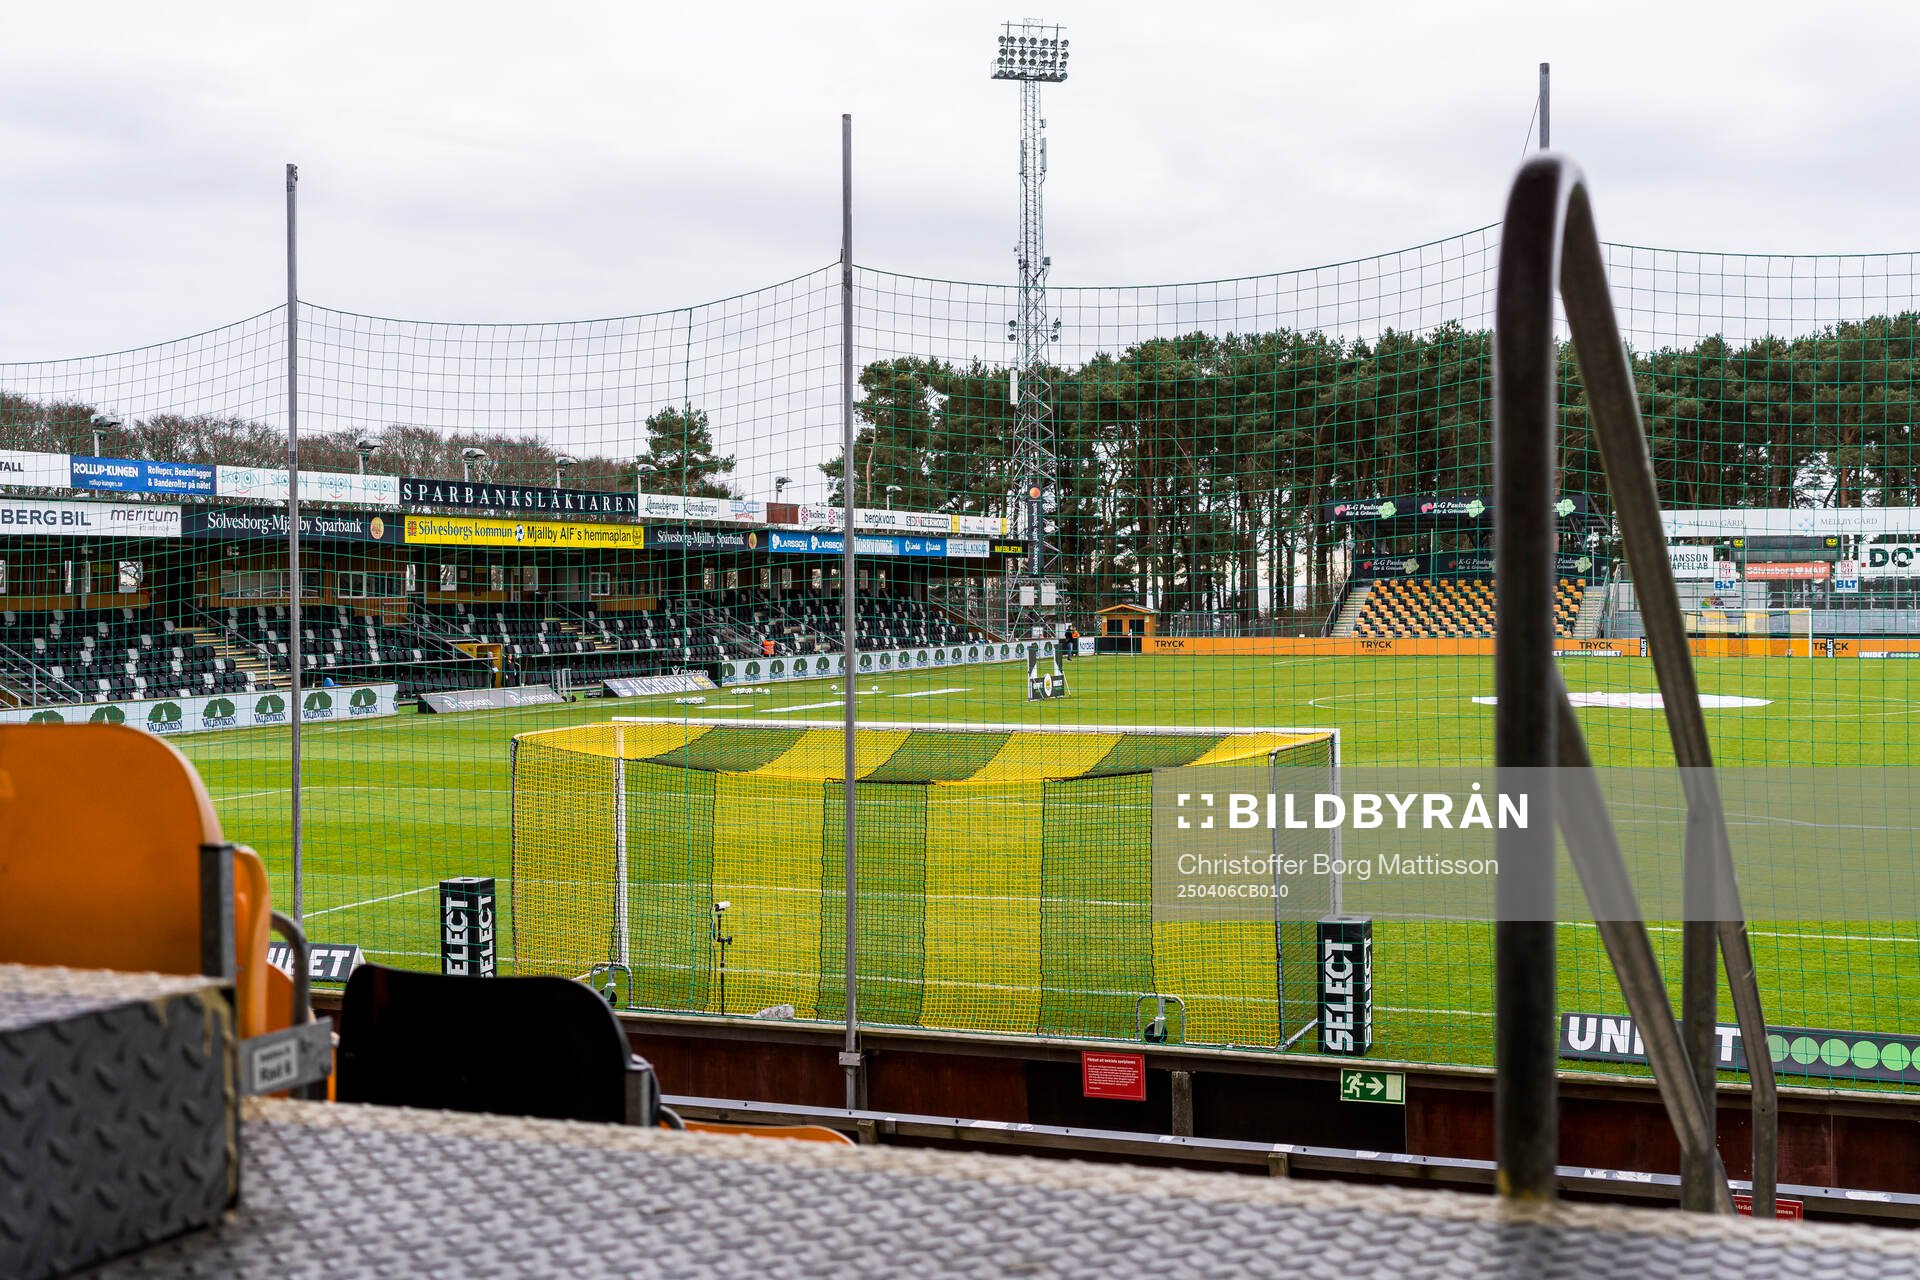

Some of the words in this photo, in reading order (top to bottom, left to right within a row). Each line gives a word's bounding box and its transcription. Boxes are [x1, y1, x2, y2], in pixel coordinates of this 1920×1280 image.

[73, 463, 139, 477] ROLLUP-KUNGEN
[147, 478, 153, 486] &
[403, 483, 637, 513] SPARBANKSLÄKTAREN
[2, 508, 56, 525] BERG
[62, 510, 91, 526] BIL
[110, 508, 178, 522] meritum
[315, 517, 362, 536] Sparbank
[418, 521, 473, 540] Sölvesborgs
[475, 522, 513, 538] kommun
[527, 526, 557, 542] Mjällby
[584, 527, 631, 544] hemmaplan
[657, 530, 716, 547] Sölvesborg-Mjällby
[717, 533, 744, 547] Sparbank
[1697, 562, 1708, 570] AB
[1805, 567, 1827, 575] MAIF
[1715, 580, 1735, 588] BLT
[1836, 580, 1857, 589] BLT
[1155, 640, 1185, 648] TRYCK
[1579, 641, 1613, 650] TRYCK
[446, 897, 468, 976] ELECT
[1325, 939, 1353, 1052] SELECT
[1568, 1016, 1742, 1062] UNIT
